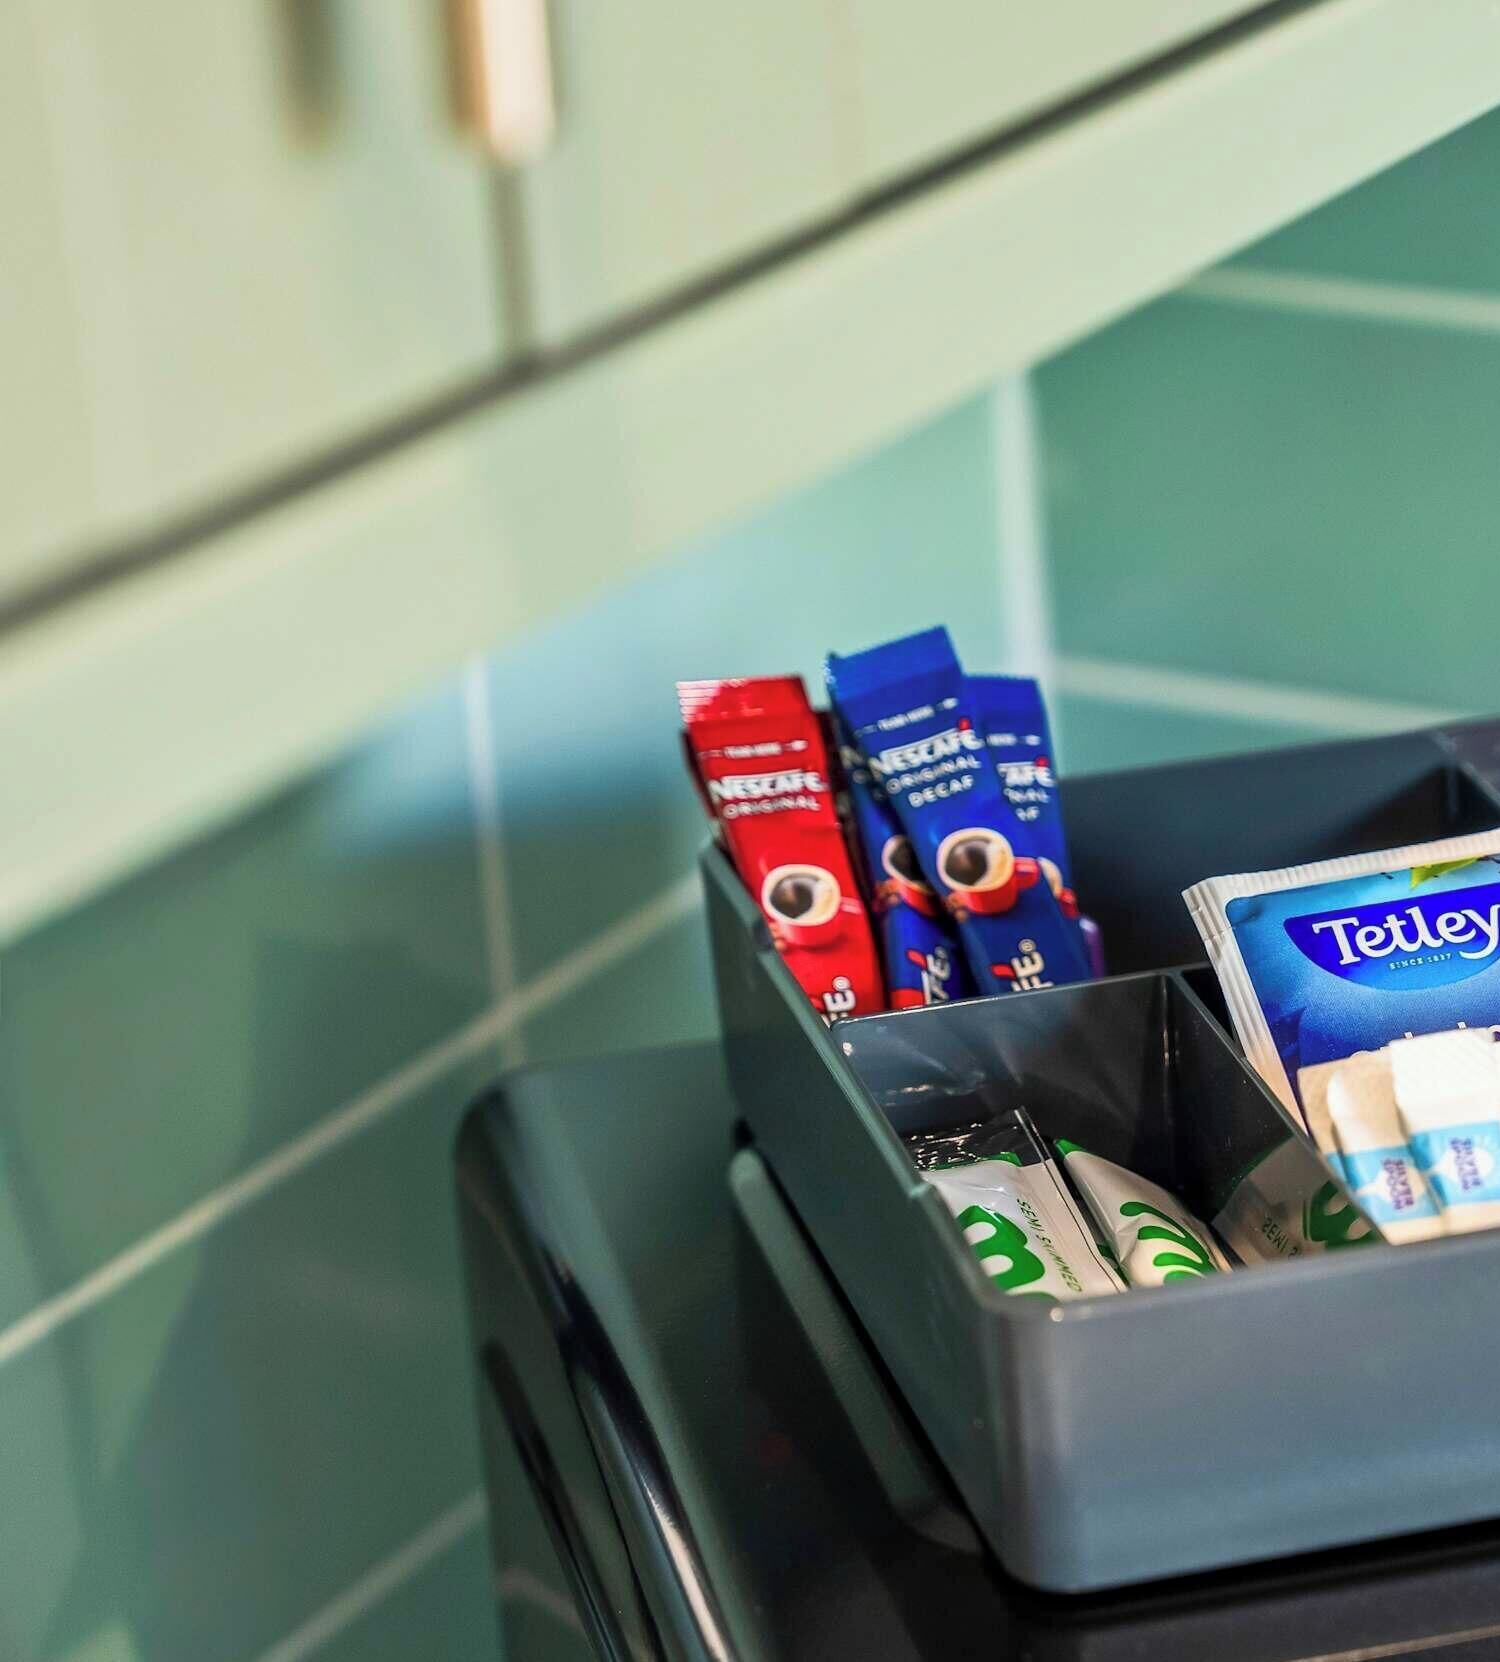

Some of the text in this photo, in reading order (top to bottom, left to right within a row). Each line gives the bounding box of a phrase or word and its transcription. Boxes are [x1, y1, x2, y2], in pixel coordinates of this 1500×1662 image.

[886, 754, 981, 794] ORIGINAL
[908, 774, 974, 808] DECAF
[723, 795, 821, 819] ORIGINAL
[1312, 904, 1500, 967] Tetley
[1389, 957, 1424, 971] SINCE
[1017, 1198, 1083, 1293] SEMI SKIMMED
